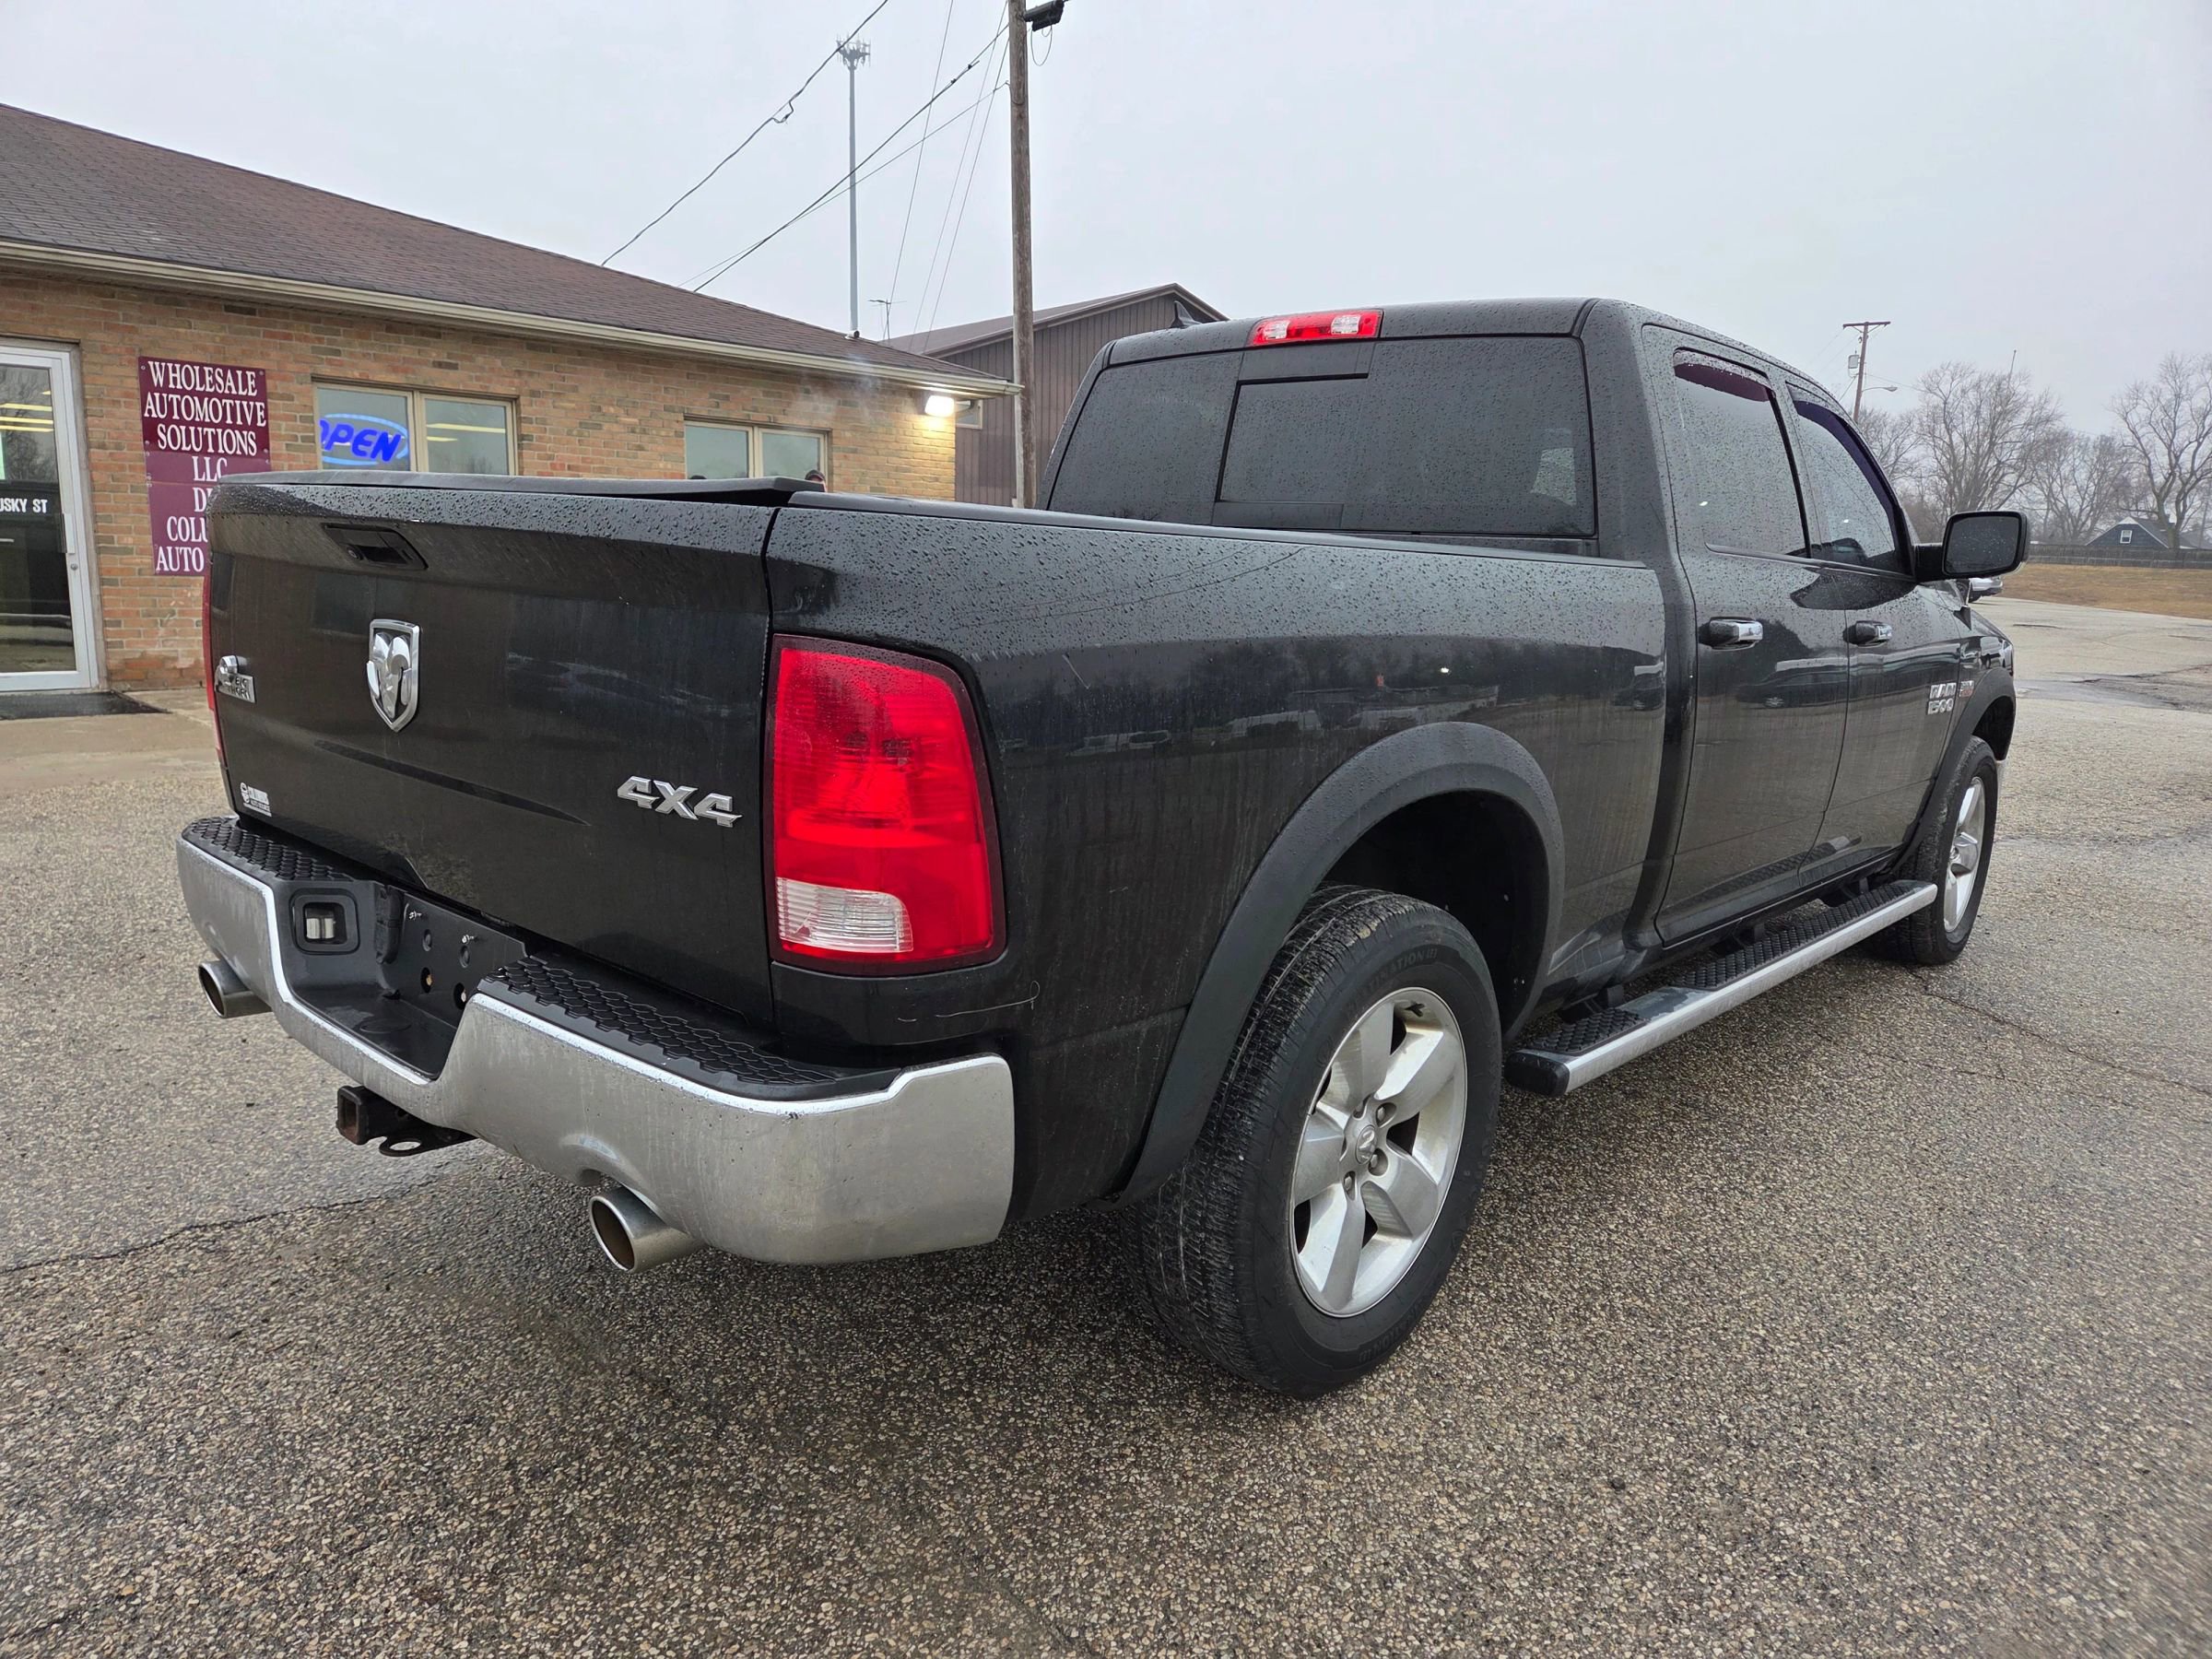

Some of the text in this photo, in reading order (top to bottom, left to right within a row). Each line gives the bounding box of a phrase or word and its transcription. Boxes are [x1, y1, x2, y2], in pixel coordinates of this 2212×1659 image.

[147, 360, 257, 396] WHOLESALE
[144, 391, 266, 427] AUTOMOTIVE
[157, 423, 257, 456] SOLUTIONS
[192, 455, 228, 482] LLC
[32, 499, 48, 513] ST
[156, 546, 205, 572] AUTO
